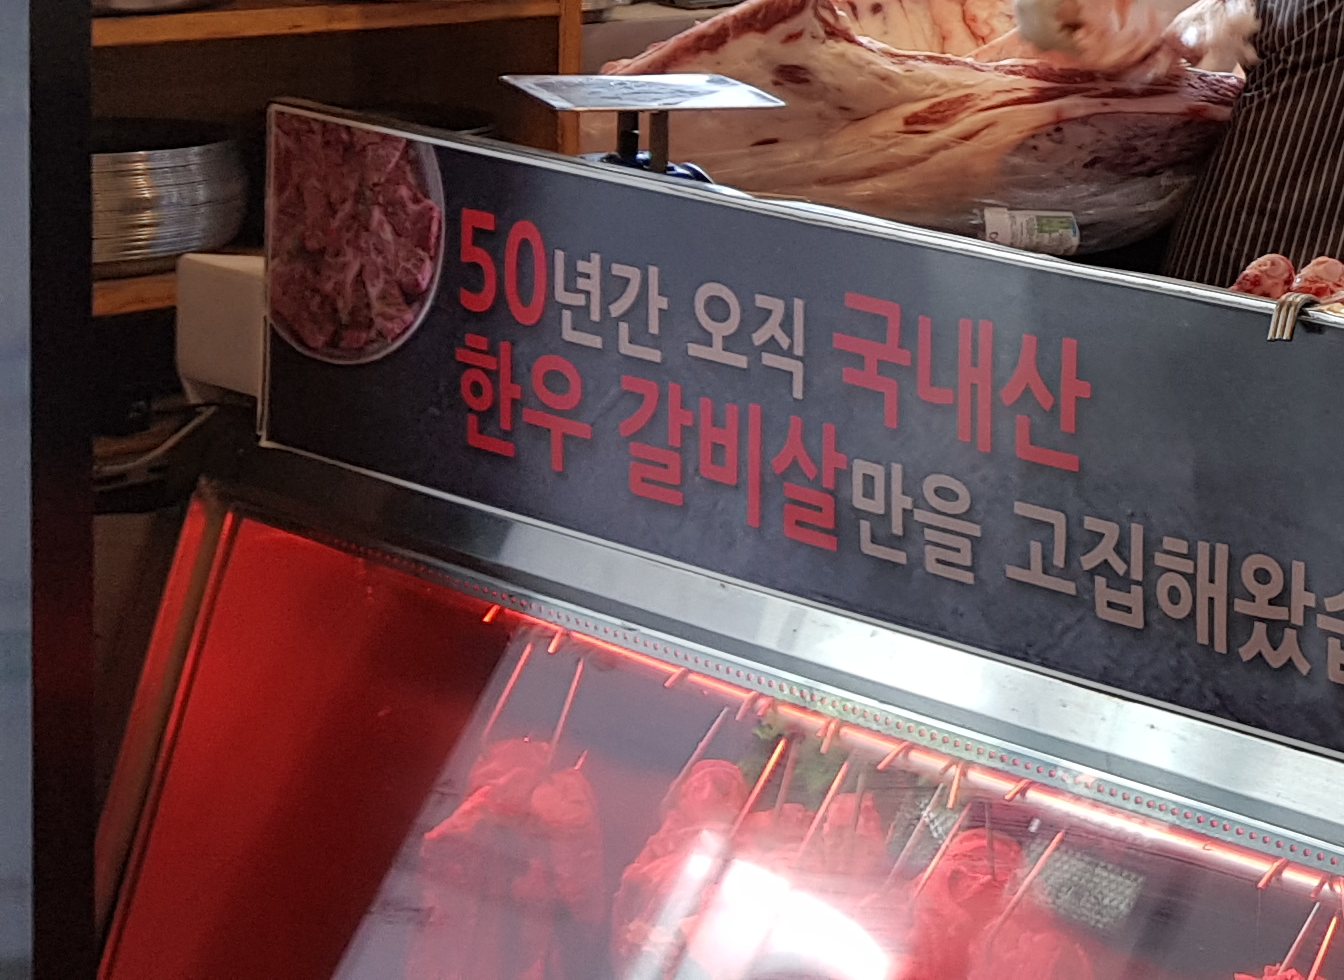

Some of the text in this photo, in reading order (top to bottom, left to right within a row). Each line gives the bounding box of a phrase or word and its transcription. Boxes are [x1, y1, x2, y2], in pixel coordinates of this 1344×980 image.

[455, 333, 591, 472] 한우
[617, 376, 982, 584] 갈비살만을
[457, 209, 1090, 472] 50년간 오직 국내산
